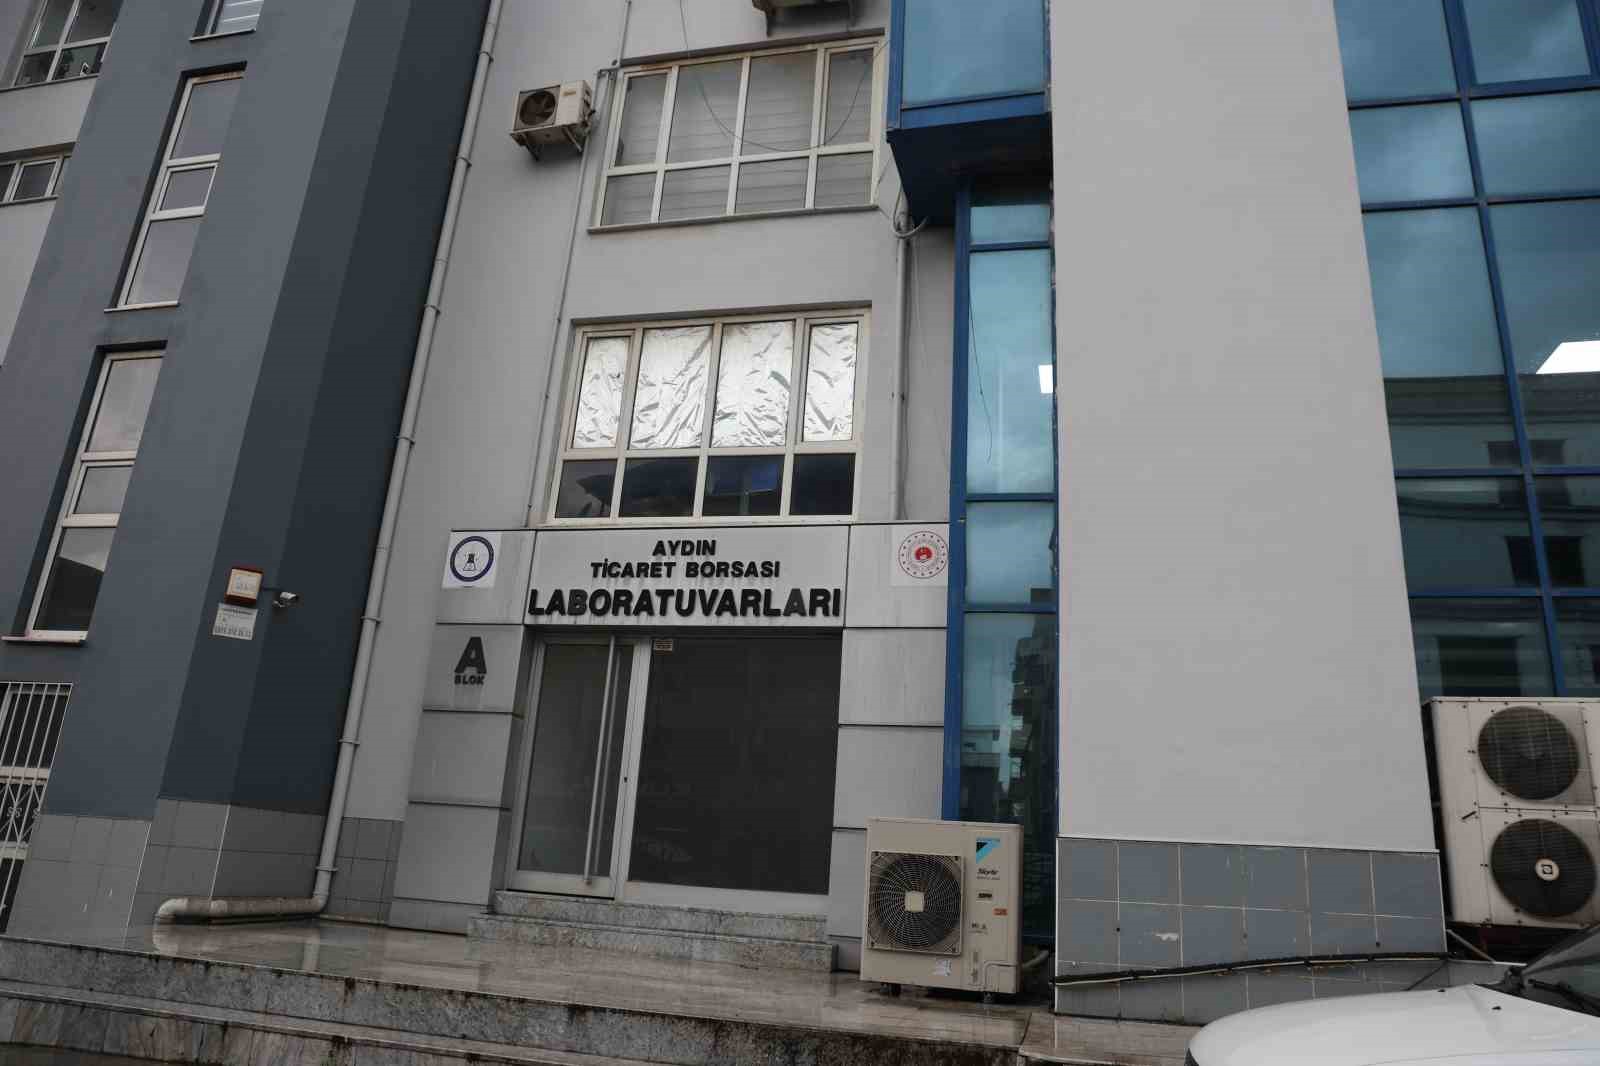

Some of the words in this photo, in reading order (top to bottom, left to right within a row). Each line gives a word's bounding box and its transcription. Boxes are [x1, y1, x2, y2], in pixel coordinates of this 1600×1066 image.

[652, 540, 717, 556] AYDIN
[590, 558, 677, 578] TİCARET
[684, 561, 780, 578] BORSASI
[527, 588, 841, 617] LABORATUVARLARI
[454, 636, 487, 674] A
[454, 675, 485, 686] BLOK
